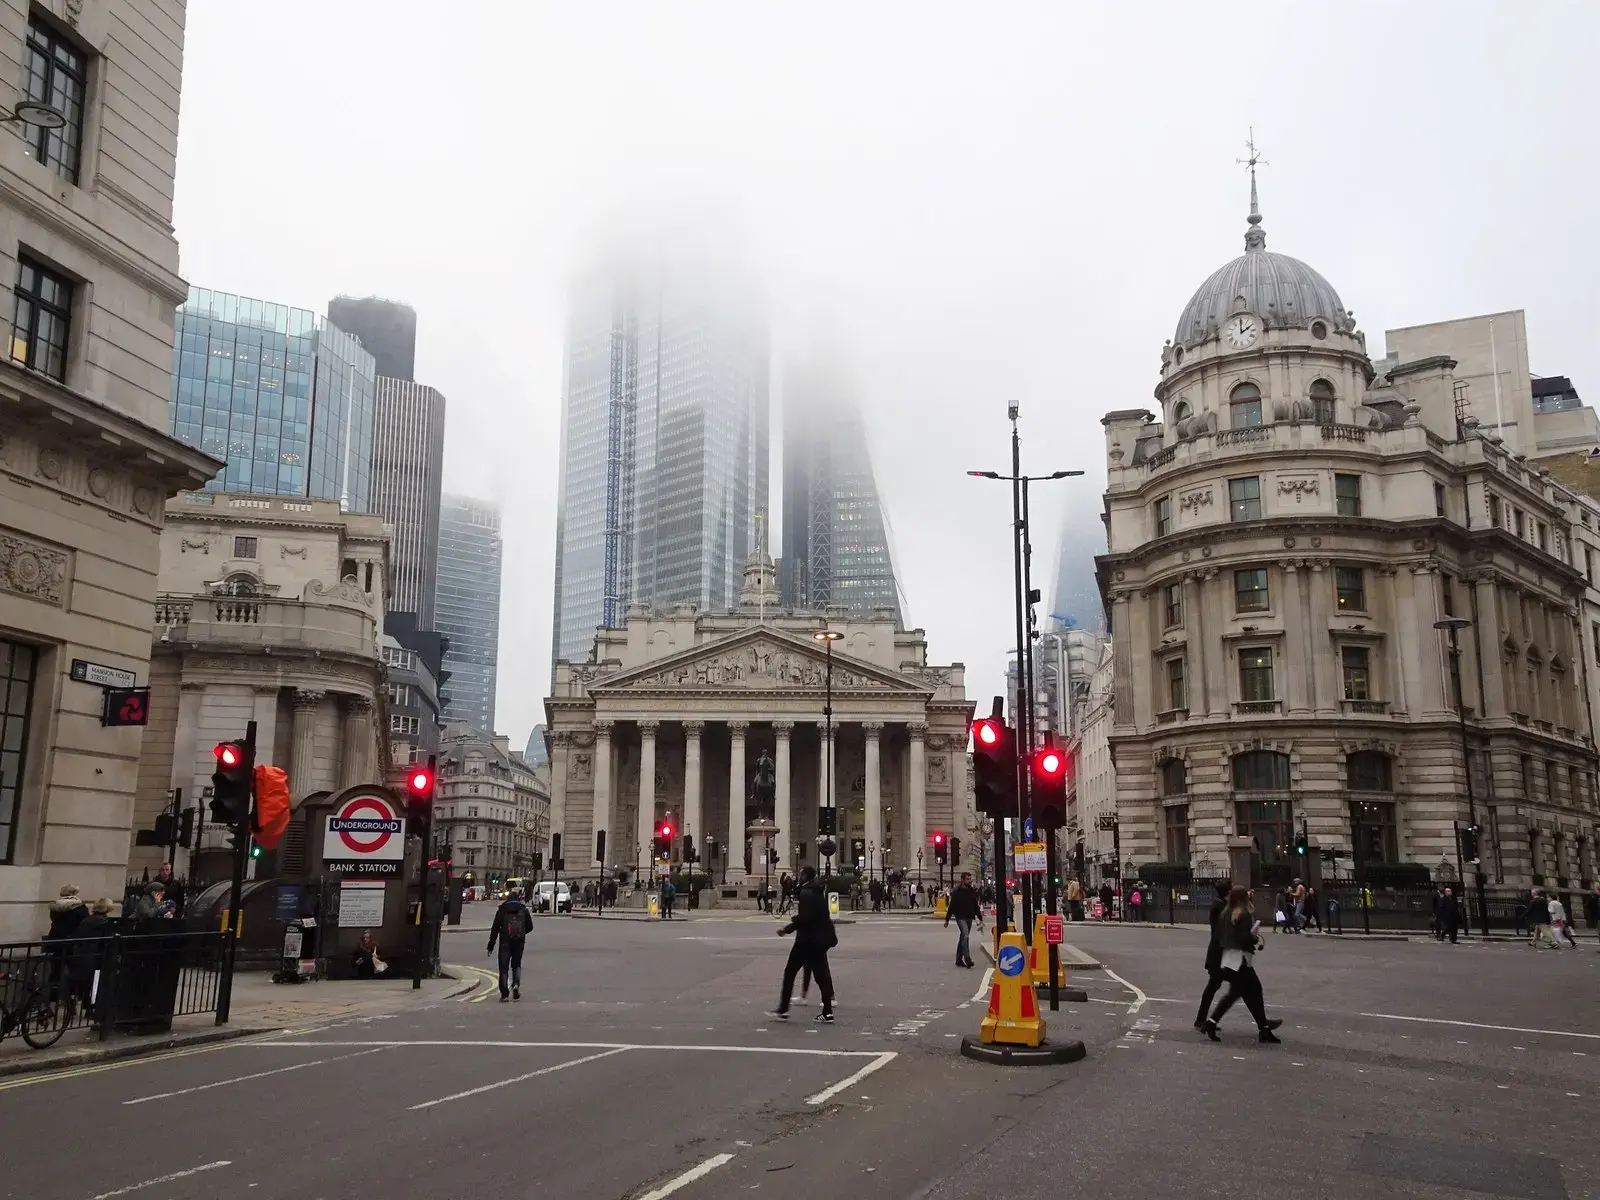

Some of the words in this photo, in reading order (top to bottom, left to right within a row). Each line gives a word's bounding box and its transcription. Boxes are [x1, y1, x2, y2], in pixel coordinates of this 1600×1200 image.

[92, 667, 114, 677] MANSION
[116, 672, 131, 680] HOUSE
[333, 820, 398, 831] UNDERGROUND
[330, 863, 355, 872] BANK
[358, 864, 396, 872] STATION
